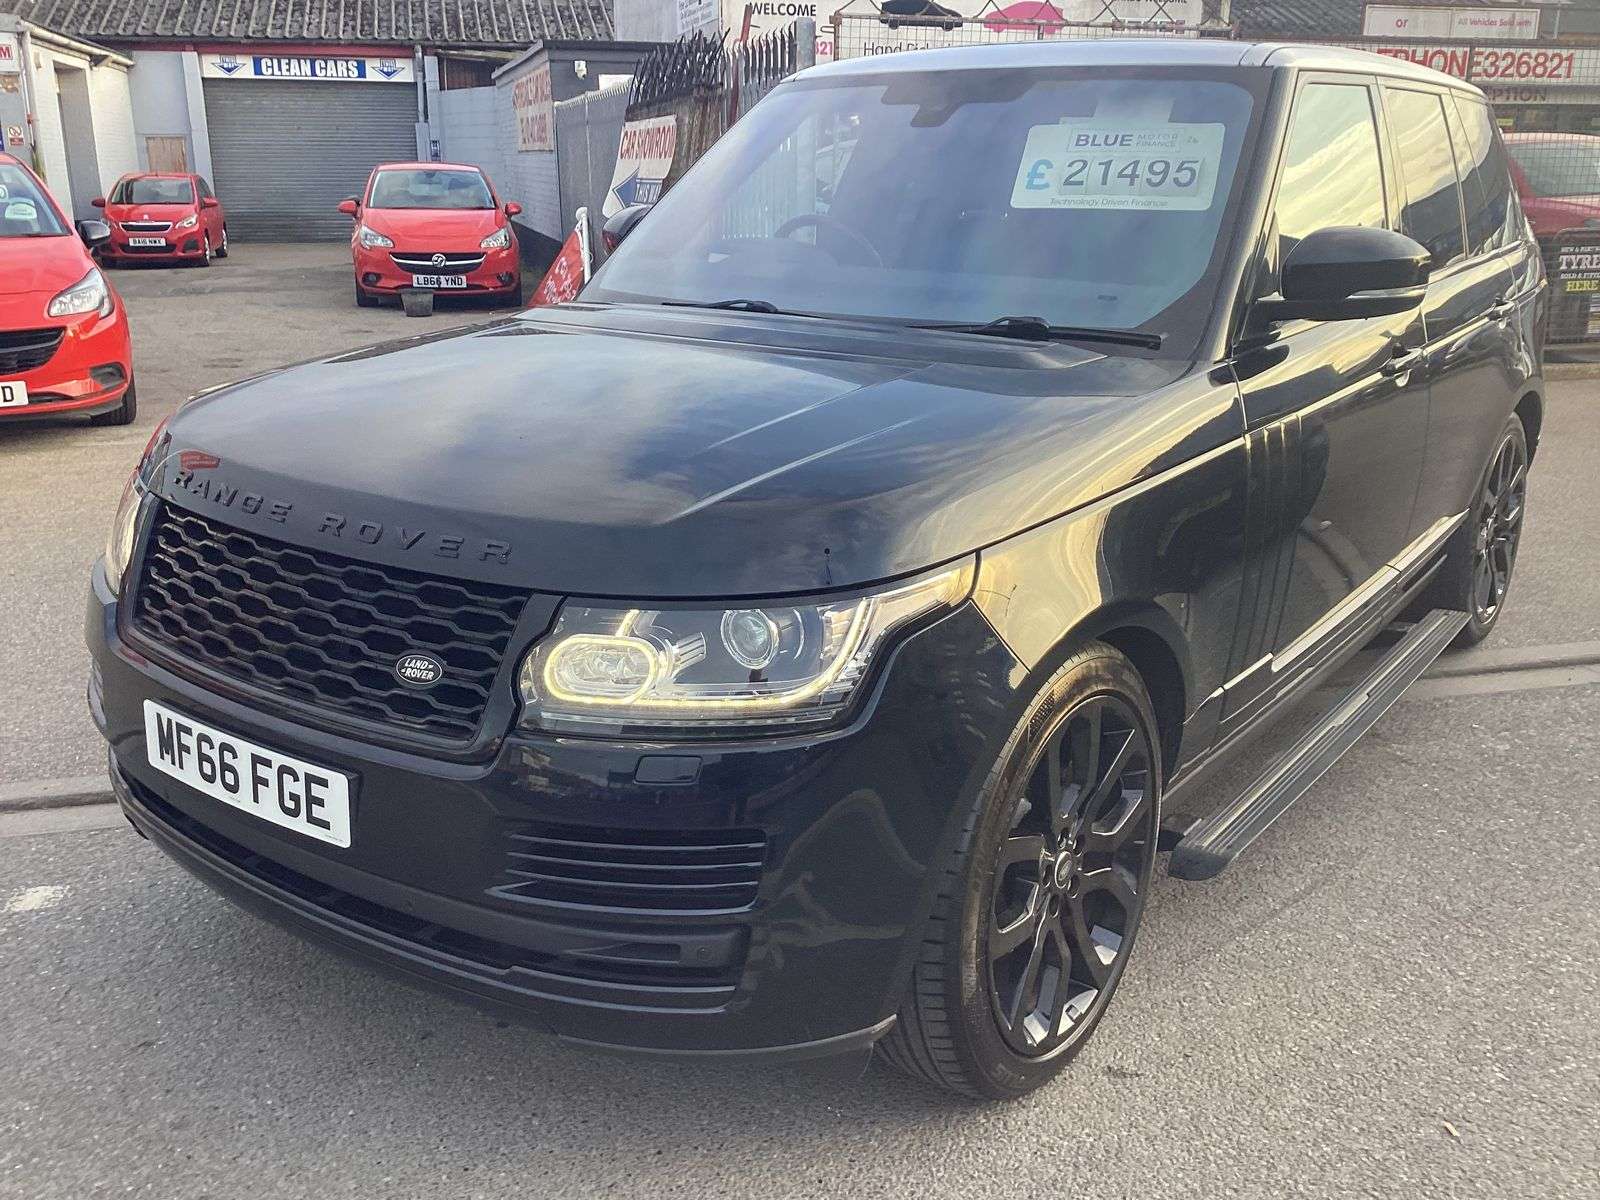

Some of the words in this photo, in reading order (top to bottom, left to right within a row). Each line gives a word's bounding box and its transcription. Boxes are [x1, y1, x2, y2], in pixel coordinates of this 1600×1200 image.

[751, 3, 816, 16] WELCOME
[1395, 18, 1409, 28] or
[1469, 18, 1497, 27] Vehicles
[260, 57, 312, 77] CLEAN
[315, 59, 359, 78] CARS
[620, 129, 637, 159] CAR
[1074, 134, 1134, 147] BLUE
[1050, 198, 1099, 207] Technology
[1101, 198, 1130, 206] Driven
[1131, 199, 1168, 207] Finance
[1559, 254, 1600, 270] TYRE
[416, 276, 442, 286] LB66
[444, 276, 463, 286] YND
[1566, 280, 1599, 292] HERE
[1, 385, 15, 402] D
[173, 469, 293, 523] RANGE
[318, 512, 513, 565] ROVER
[156, 712, 240, 794] MF66
[250, 752, 331, 831] FGE
